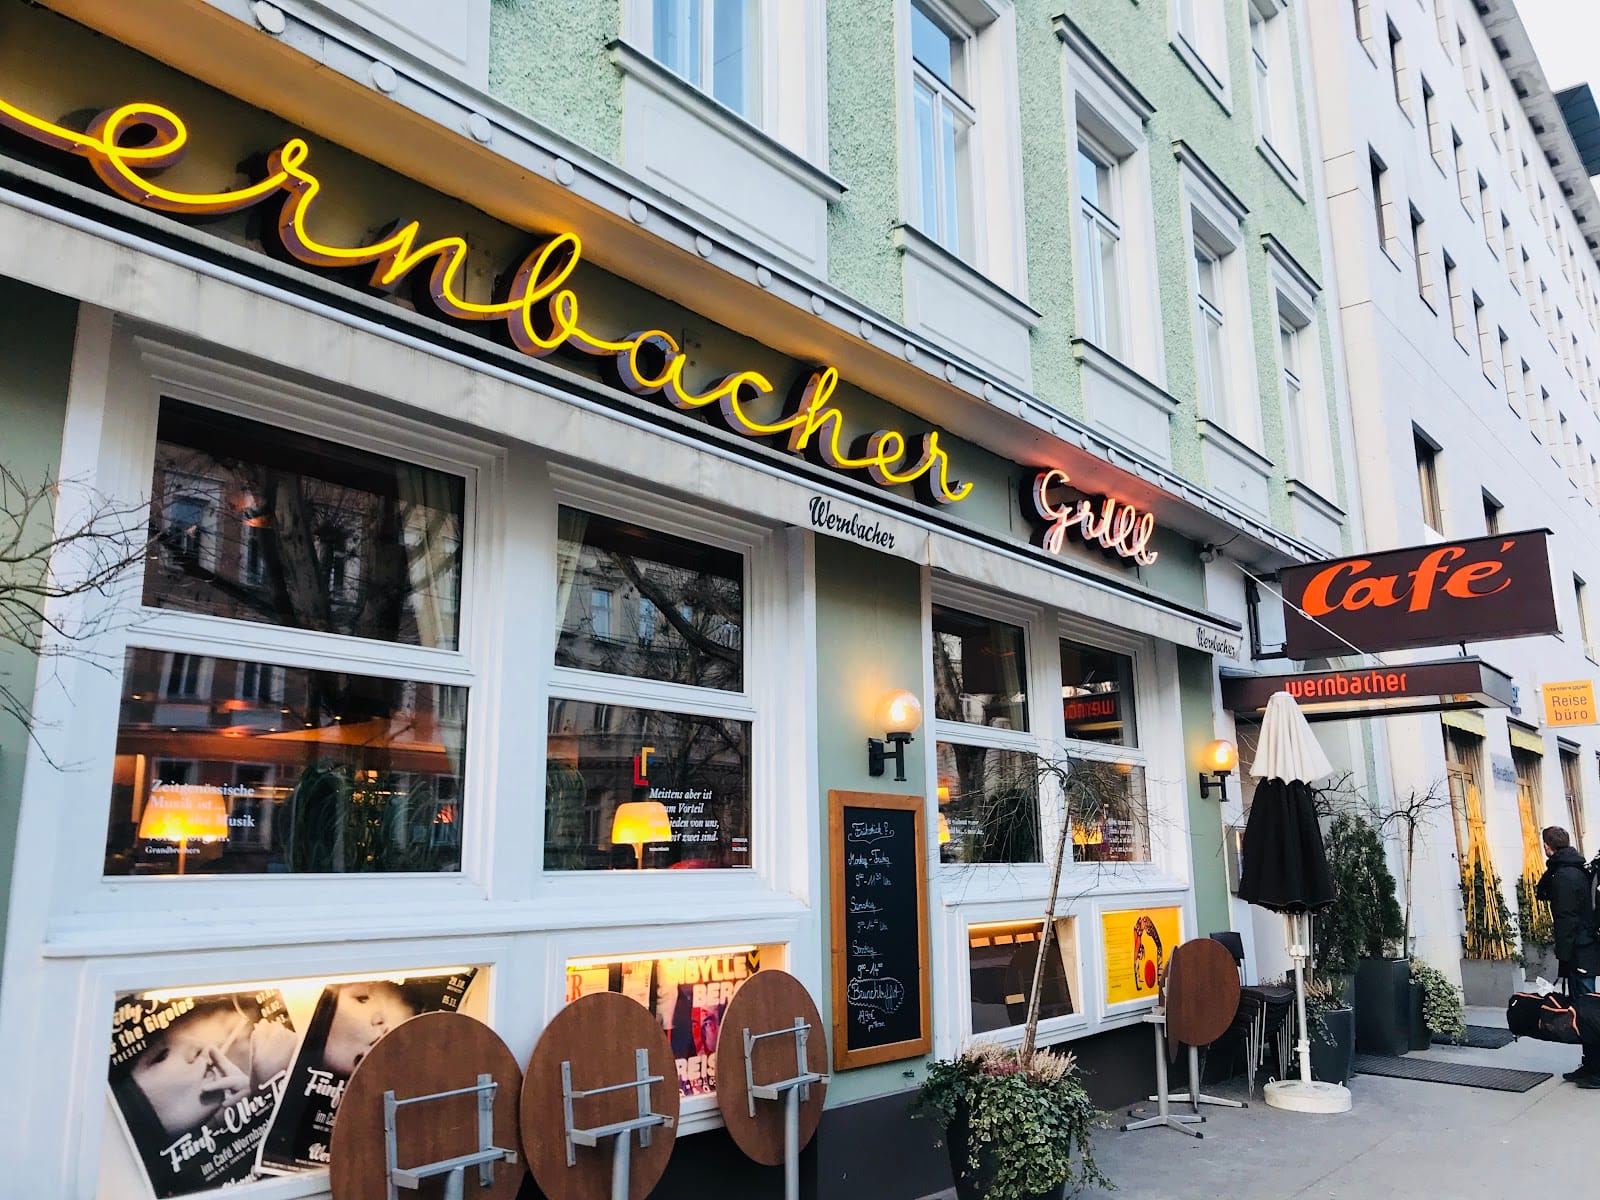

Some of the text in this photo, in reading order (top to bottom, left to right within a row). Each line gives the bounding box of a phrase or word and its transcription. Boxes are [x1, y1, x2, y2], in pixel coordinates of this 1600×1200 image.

[0, 98, 974, 503] ernbacher
[809, 496, 895, 551] Wernbacher
[1302, 541, 1516, 617] Café
[1195, 627, 1236, 656] Wernbacher
[1285, 670, 1407, 699] wernbacher
[1551, 694, 1588, 708] Reise
[1553, 708, 1589, 721] büro
[151, 779, 255, 797] Zeitgenössische
[649, 788, 713, 800] Meistens aber ist
[678, 803, 704, 814] Vorteil
[689, 819, 704, 828] von
[704, 819, 720, 829] uns,
[681, 831, 701, 842] zwei
[566, 974, 583, 1003] R
[118, 1026, 145, 1048] the
[143, 997, 195, 1033] Gigolos
[111, 1040, 147, 1066] PRESENT
[315, 1110, 327, 1124] im
[201, 1160, 215, 1177] im
